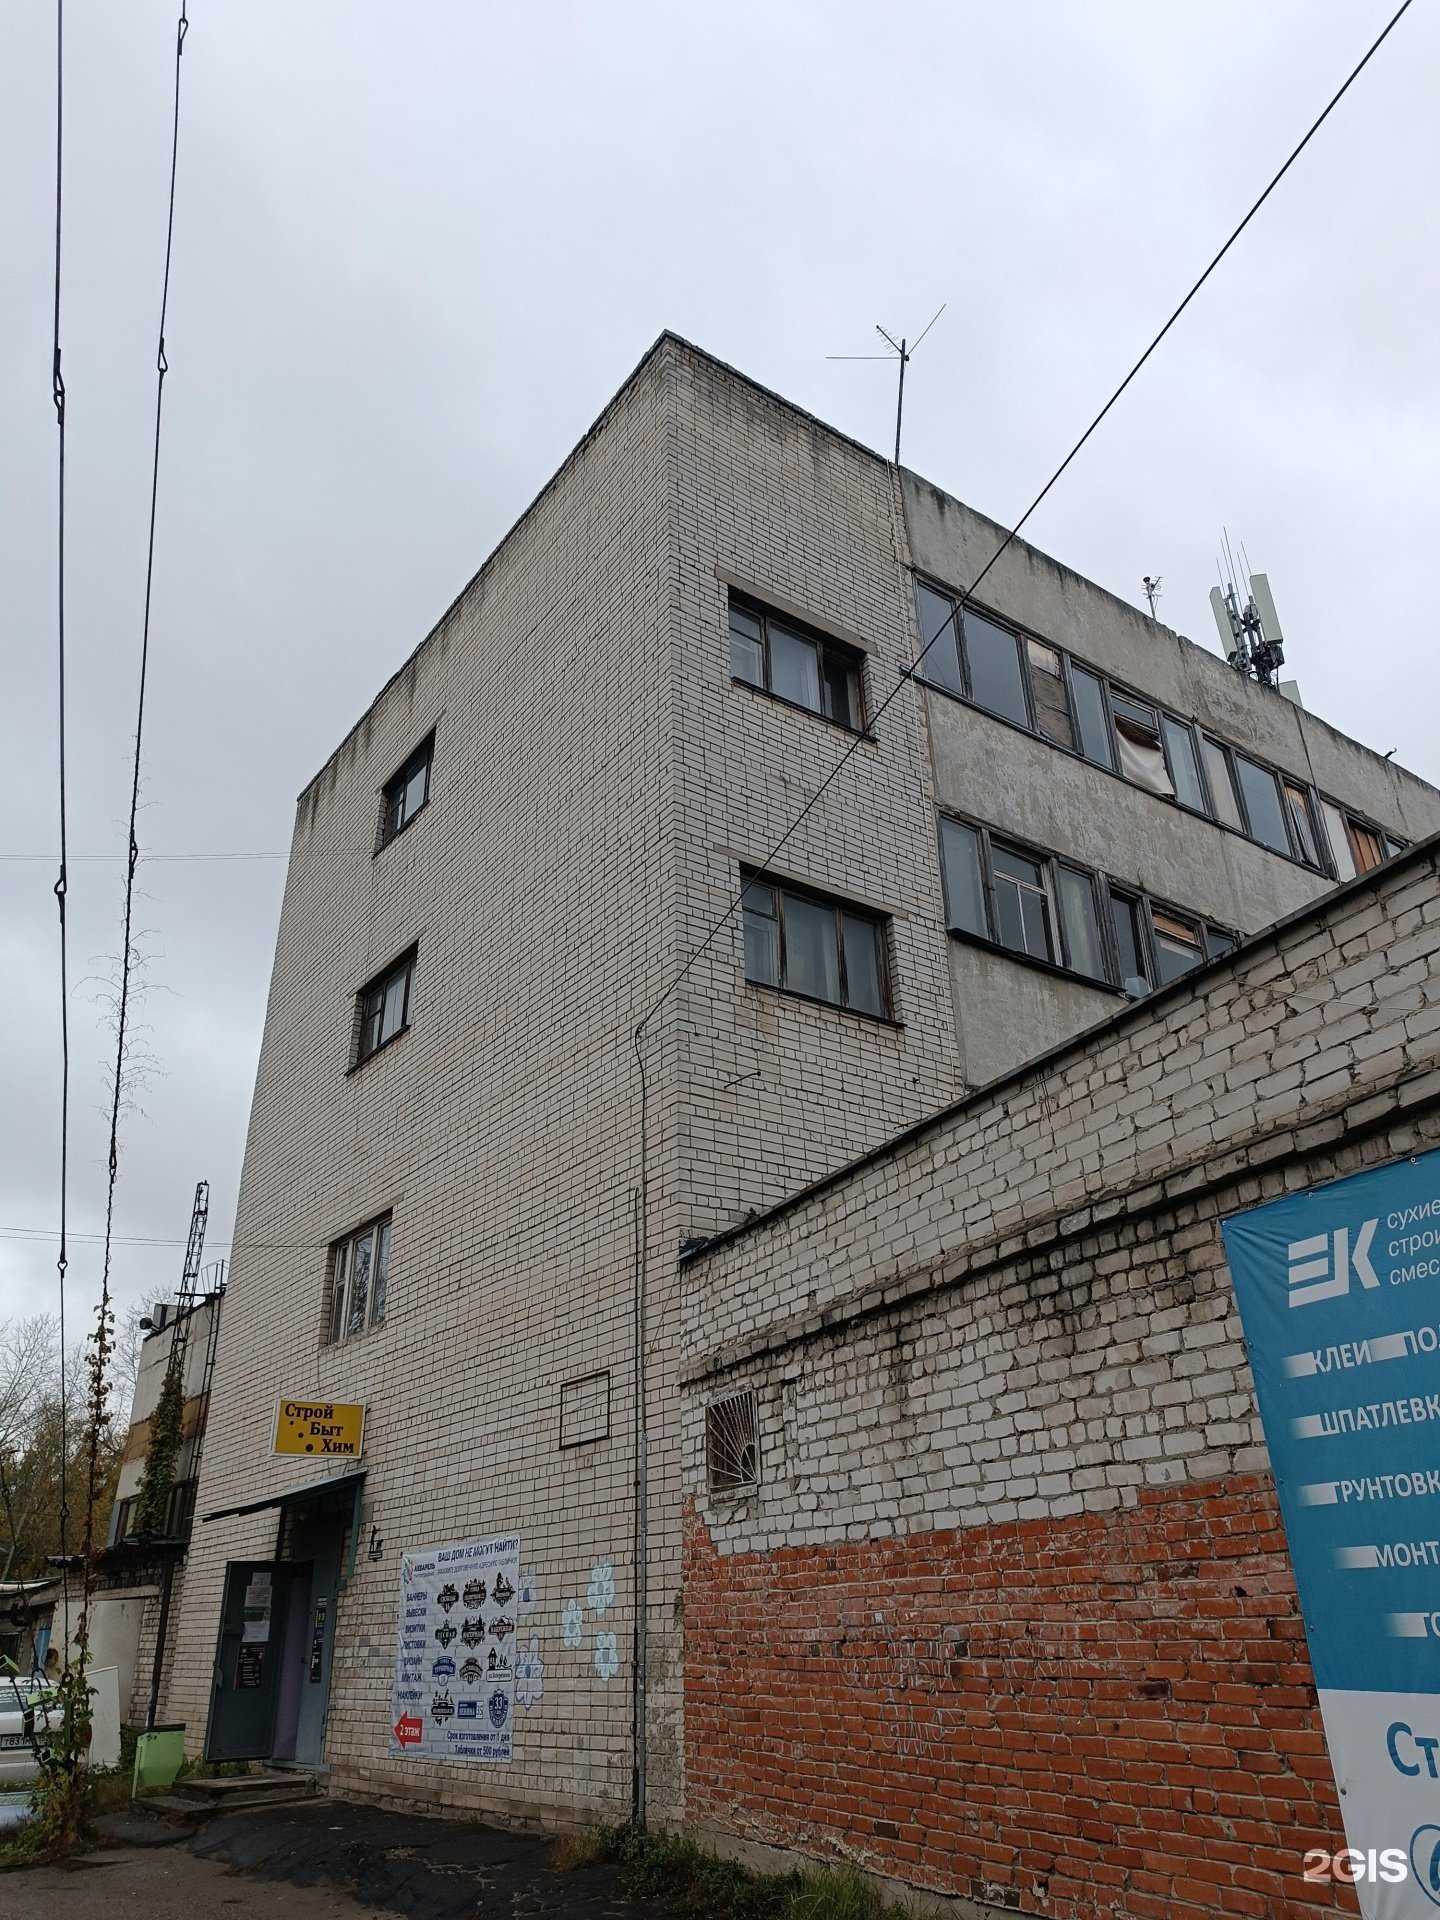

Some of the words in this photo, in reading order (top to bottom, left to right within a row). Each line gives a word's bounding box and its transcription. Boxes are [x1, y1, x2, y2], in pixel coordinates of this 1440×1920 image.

[1387, 1199, 1440, 1231] сухие
[1313, 1339, 1373, 1374] КЛЕИ
[285, 1403, 334, 1421] Строй
[310, 1422, 344, 1437] Быт
[320, 1438, 354, 1454] Хим
[451, 1548, 465, 1562] ДОМ
[465, 1547, 473, 1558] НЕ
[473, 1544, 494, 1558] МОГУТ
[406, 1591, 427, 1602] БАННЕРЫ
[406, 1607, 427, 1618] ВЫВЕСКИ
[405, 1623, 425, 1634] ВИЗИТКИ
[400, 1724, 404, 1736] 2
[404, 1727, 420, 1737] этаж
[447, 1730, 458, 1742] Срок
